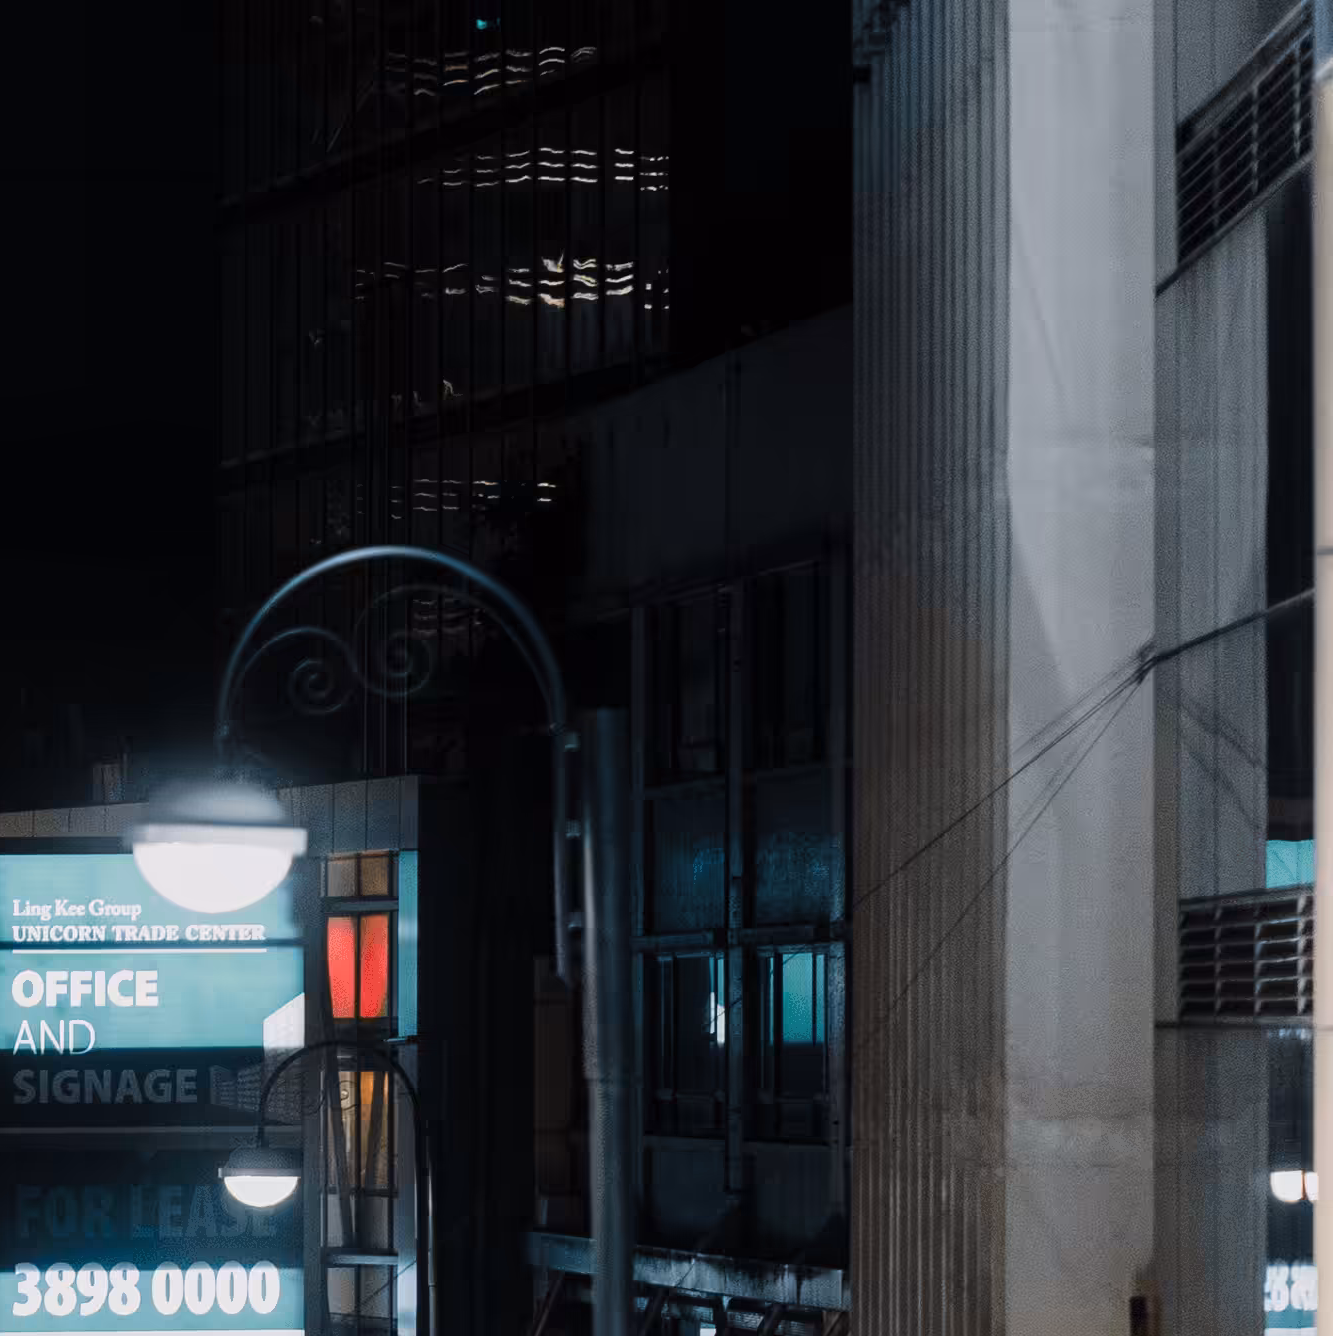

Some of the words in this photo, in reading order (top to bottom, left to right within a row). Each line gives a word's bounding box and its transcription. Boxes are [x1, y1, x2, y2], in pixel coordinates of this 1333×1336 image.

[13, 899, 51, 921] Ling
[54, 899, 85, 917] Kee
[88, 899, 142, 921] Group
[12, 925, 106, 942] UNICORN
[111, 925, 179, 942] TRADE
[185, 924, 267, 941] CENTER
[12, 970, 159, 1007] OFFICE
[13, 1019, 96, 1055] AND
[13, 1068, 198, 1104] SIGNAGE
[18, 1184, 114, 1238] FOR
[132, 1184, 277, 1238] LEASE
[12, 1261, 141, 1317] 3898
[151, 1260, 280, 1315] 0000
